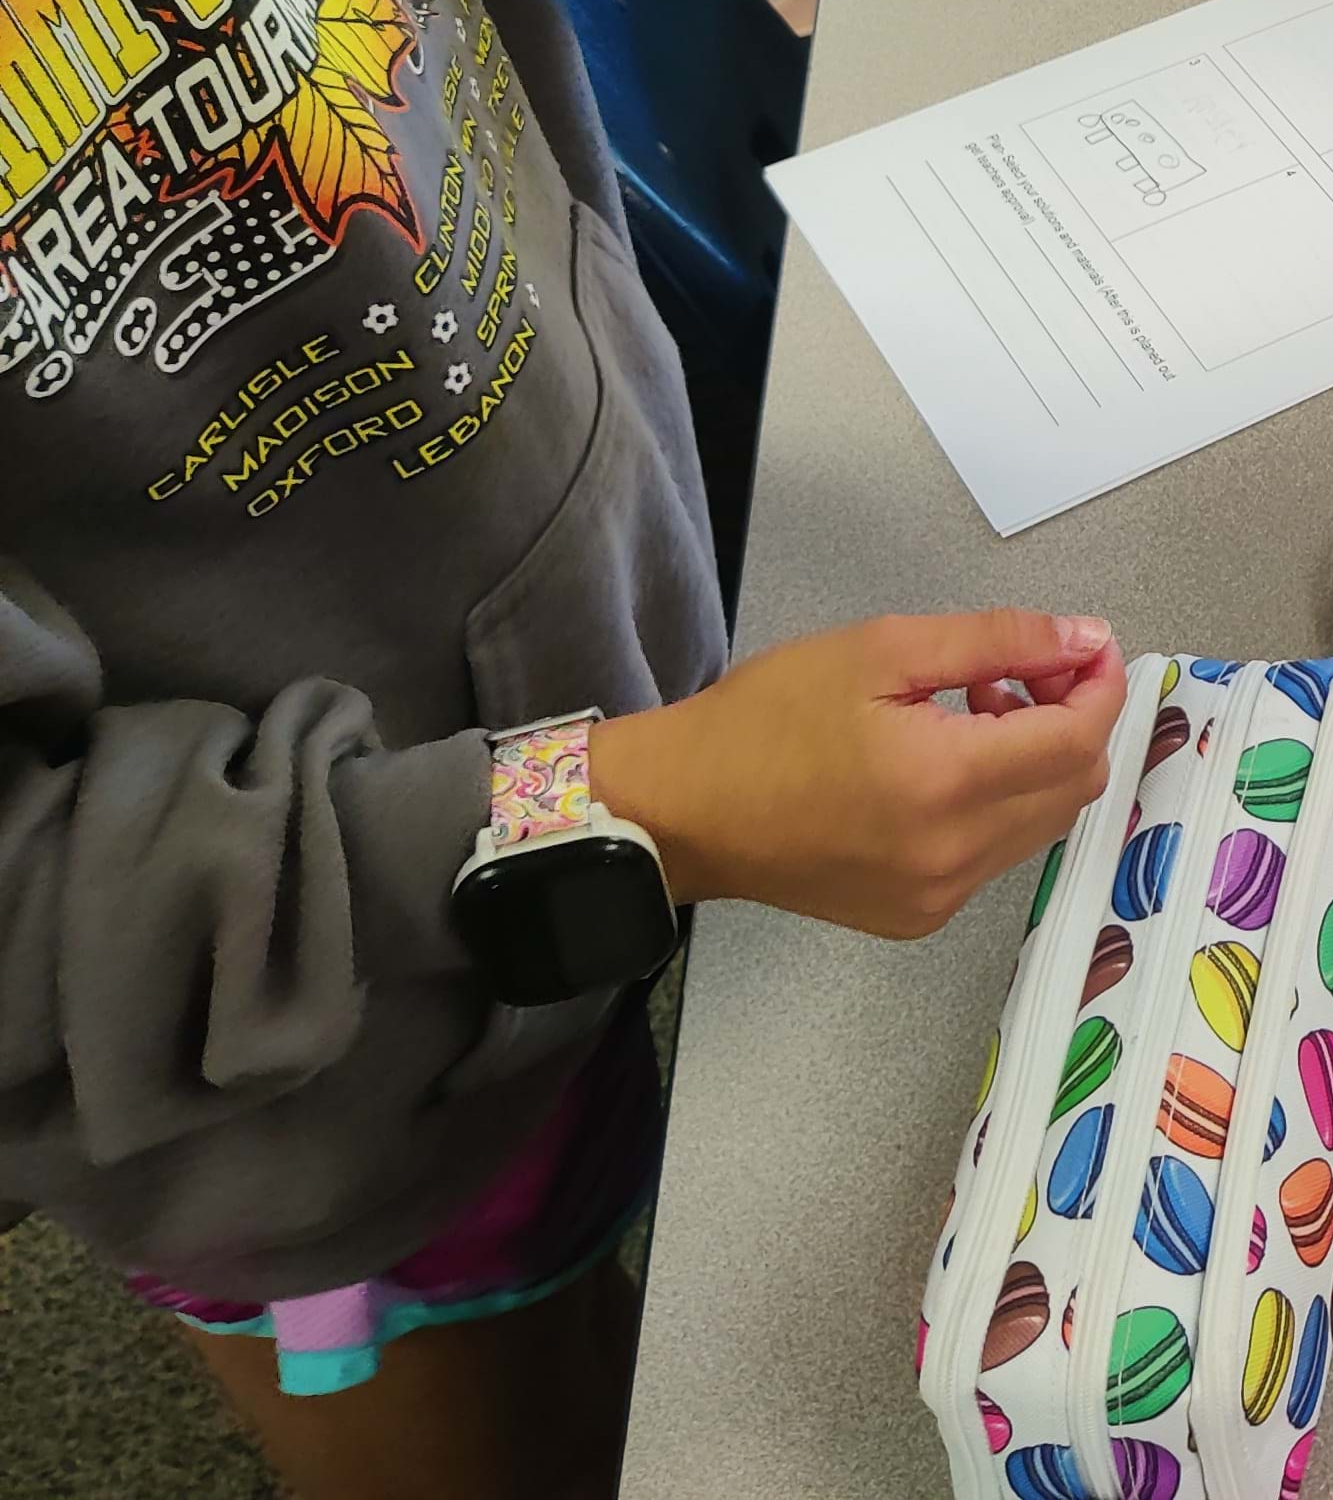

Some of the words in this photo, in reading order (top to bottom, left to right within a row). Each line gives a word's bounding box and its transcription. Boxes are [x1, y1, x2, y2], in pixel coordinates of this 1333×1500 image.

[8, 145, 148, 350] AREA
[976, 150, 1007, 189] teachers
[1002, 152, 1028, 182] Select
[1016, 178, 1040, 203] your
[1033, 197, 1065, 234] solutions
[1058, 230, 1077, 250] and
[1072, 248, 1105, 287] materials
[1097, 284, 1123, 311] (After
[1116, 307, 1135, 327] this
[1130, 324, 1141, 337] is
[1158, 364, 1178, 383] out
[147, 333, 341, 502] CARLISLE
[220, 349, 416, 493] MADISON
[245, 398, 424, 519] OXFORD
[391, 317, 538, 482] LEBANON
